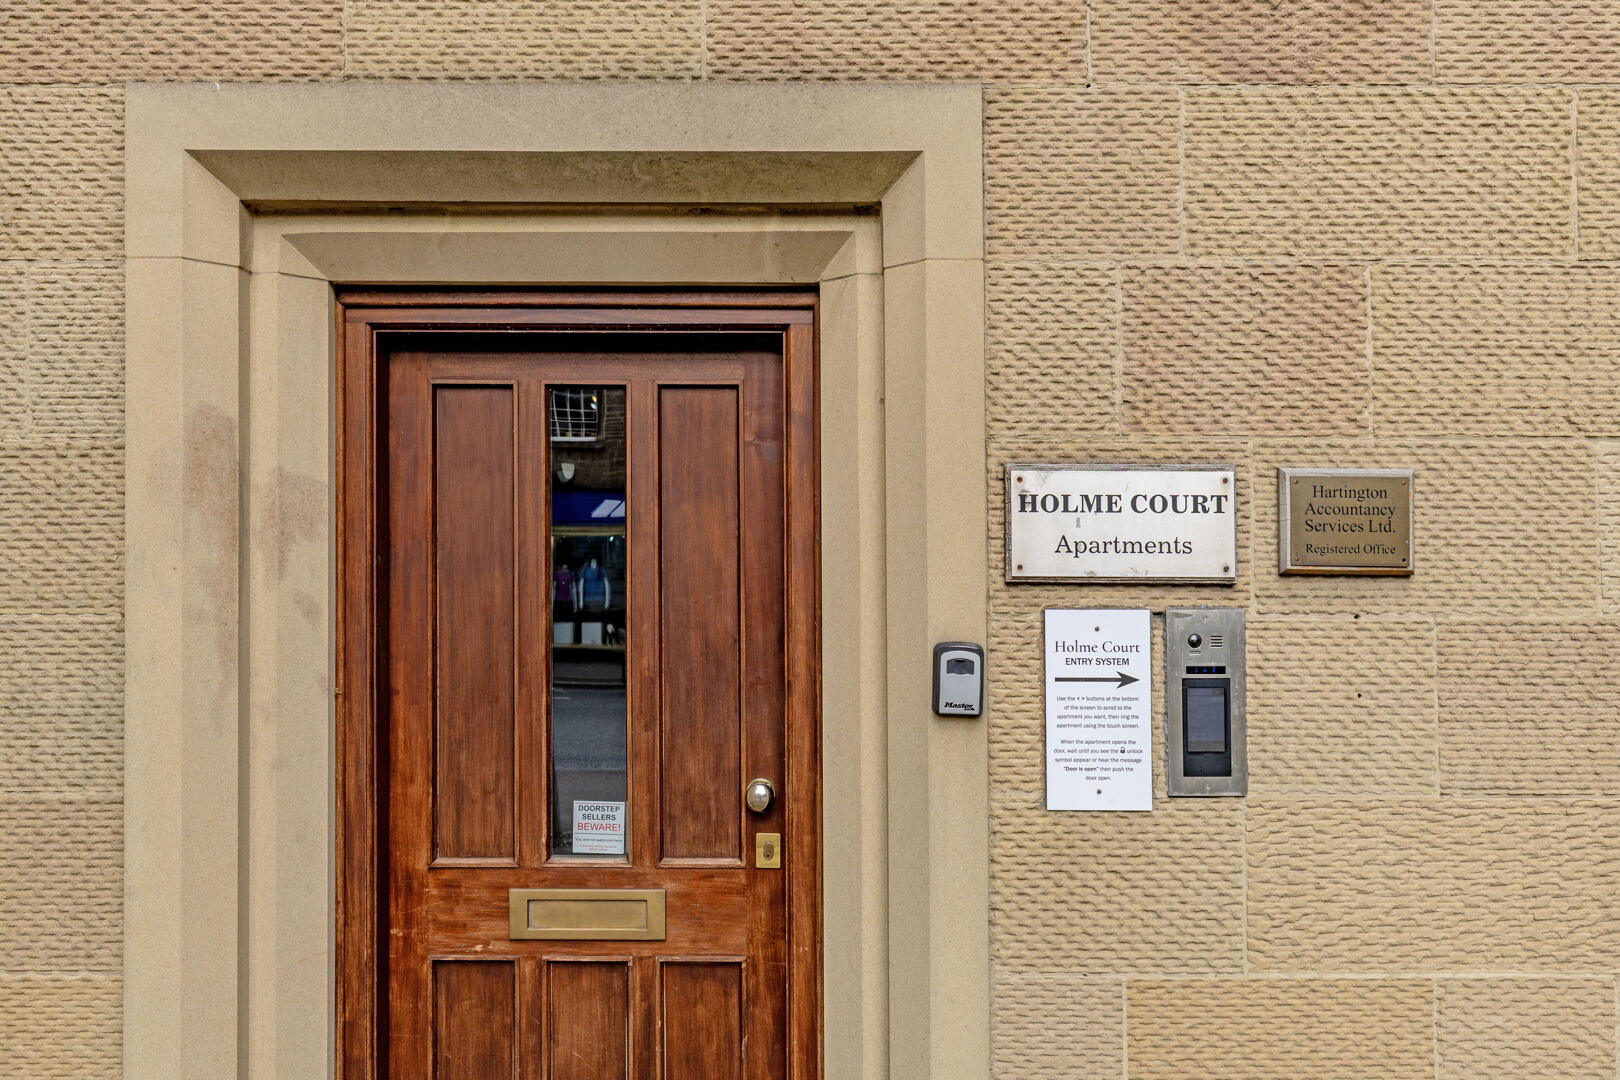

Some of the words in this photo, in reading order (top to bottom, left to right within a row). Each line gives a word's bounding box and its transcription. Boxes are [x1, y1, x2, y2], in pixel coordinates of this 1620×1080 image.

[1313, 485, 1388, 502] Hartington
[1017, 493, 1122, 514] HOLME
[1130, 493, 1228, 514] COURT
[1304, 502, 1396, 519] Accountancy
[1305, 519, 1364, 533] Services
[1368, 519, 1396, 533] Ltd.
[1055, 535, 1193, 558] Apartments
[1306, 544, 1360, 556] Registered
[1364, 544, 1396, 554] Office
[1055, 640, 1098, 653] Holme
[1102, 641, 1140, 653] Court
[578, 823, 621, 831] BEWARE!
